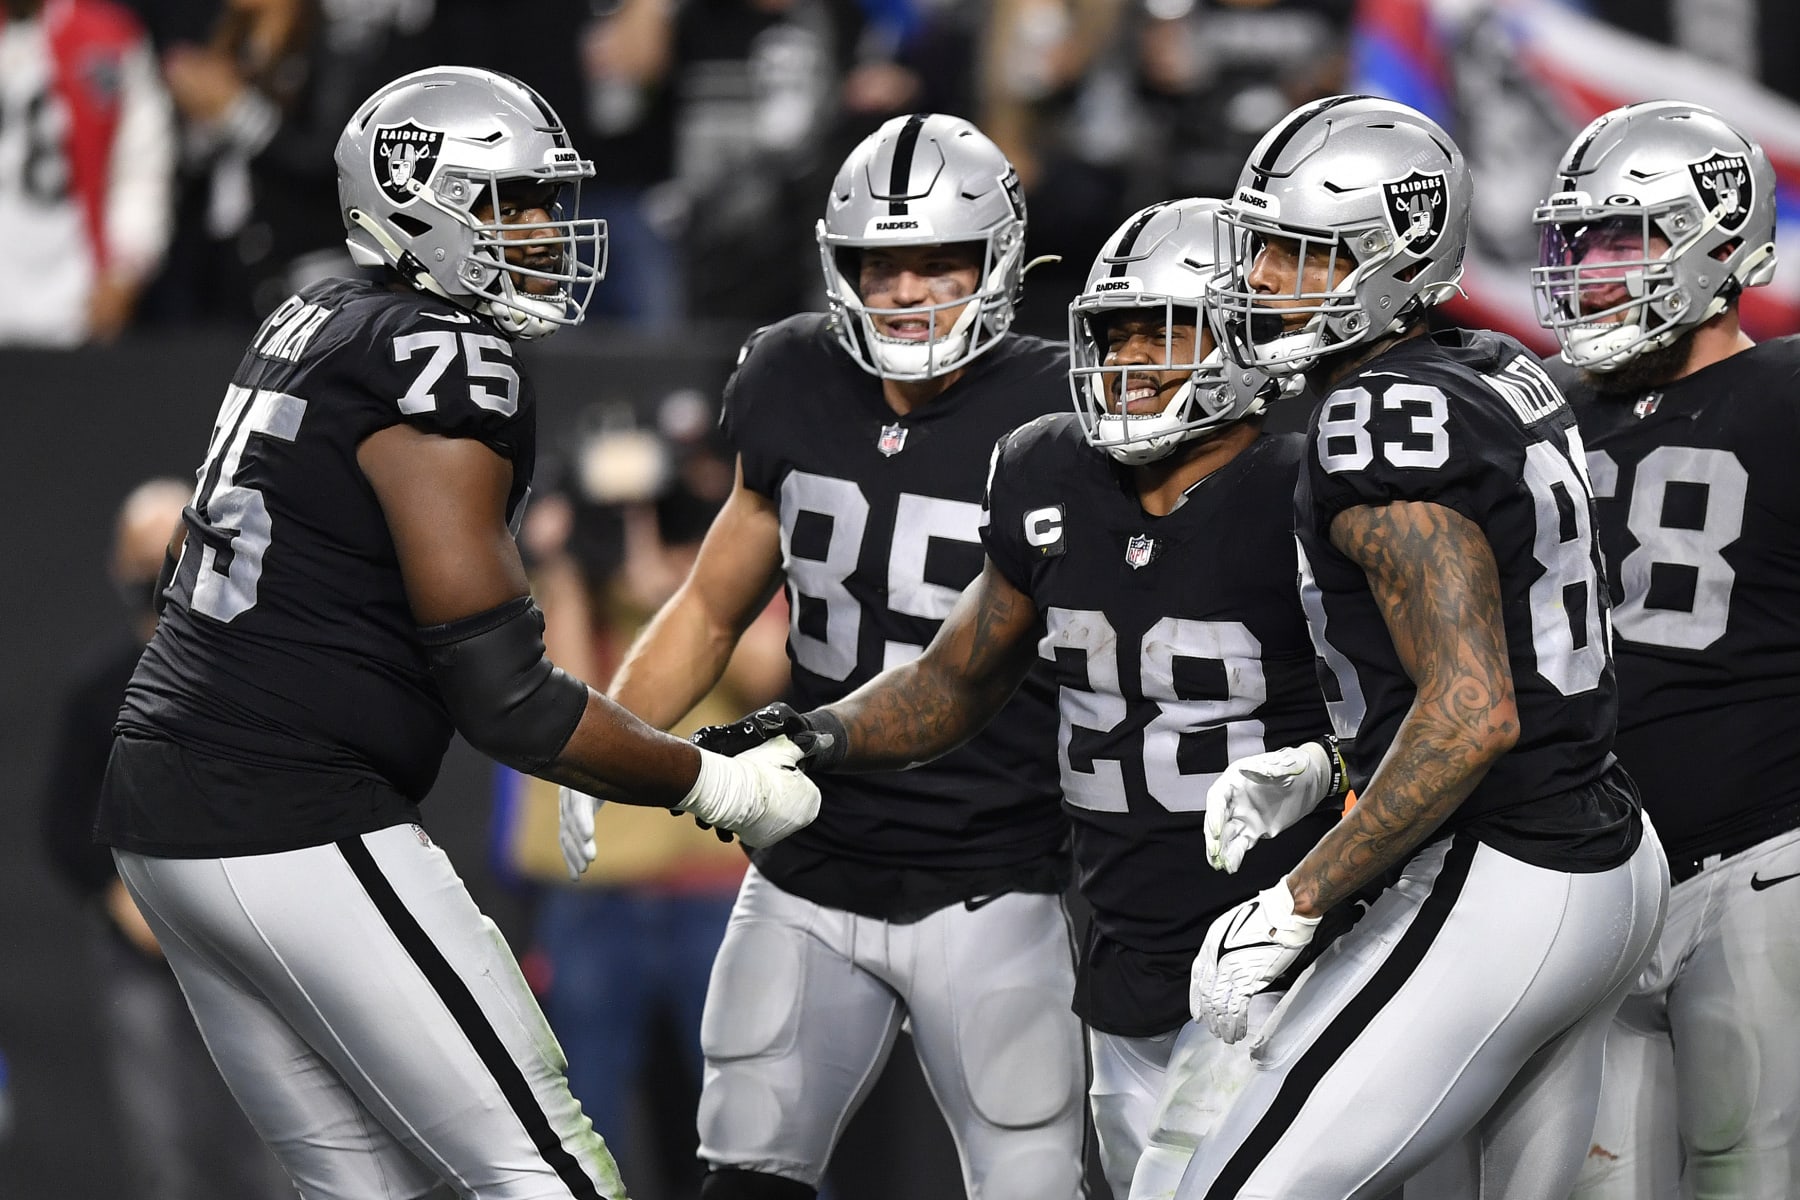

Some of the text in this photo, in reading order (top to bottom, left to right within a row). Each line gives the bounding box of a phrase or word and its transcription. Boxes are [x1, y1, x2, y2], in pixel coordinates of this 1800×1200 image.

[380, 130, 437, 142] RAIDERS
[1390, 177, 1441, 195] RAIDERS
[1691, 157, 1744, 175] RAIDERS
[1239, 191, 1268, 209] RAIDERS
[876, 221, 919, 230] RAIDERS
[1095, 281, 1130, 292] RAIDERS
[392, 330, 520, 418] 75
[1316, 383, 1450, 475] 83
[1024, 507, 1063, 547] C
[1522, 425, 1613, 697] 8
[1585, 445, 1750, 651] 8
[779, 469, 991, 683] 85
[1037, 606, 1267, 813] 28
